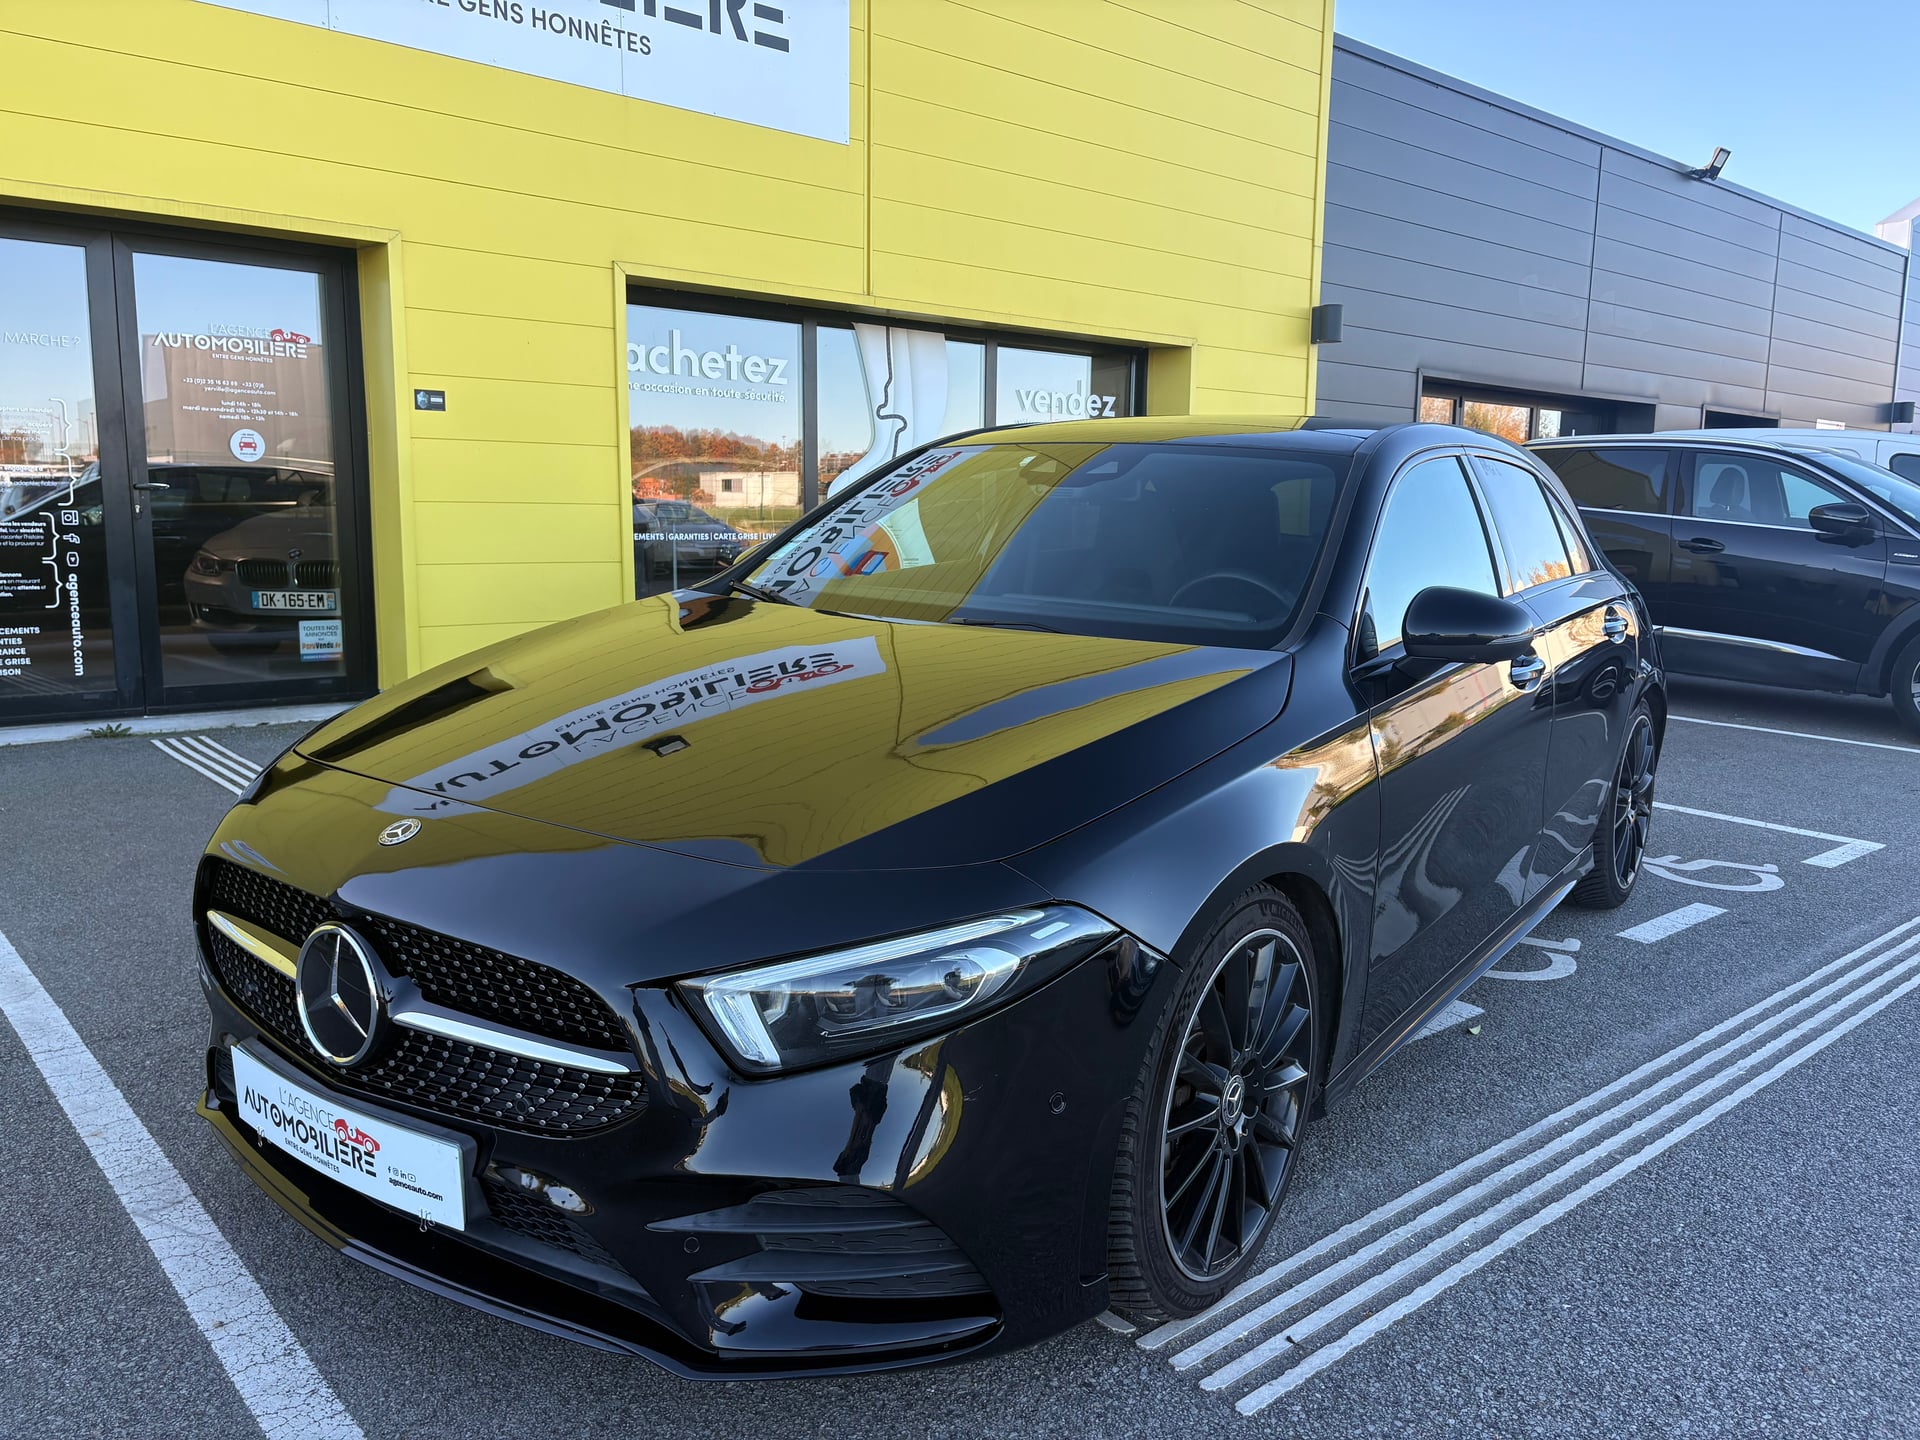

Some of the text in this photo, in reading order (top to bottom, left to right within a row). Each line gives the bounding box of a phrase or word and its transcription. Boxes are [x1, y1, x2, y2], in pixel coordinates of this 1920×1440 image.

[458, 0, 524, 24] GENS
[531, 7, 652, 56] HONNÊTES
[3, 331, 71, 348] MARCHE
[209, 323, 271, 340] L'AGENCE
[627, 328, 789, 385] achetez
[643, 384, 691, 396] occasion
[695, 388, 709, 396] en
[712, 387, 741, 400] toute
[1016, 380, 1116, 417] vendez
[668, 533, 709, 541] GARANTIES
[713, 533, 737, 541] CARTE
[738, 533, 758, 541] GRISE
[66, 573, 84, 676] agenceauto.com
[4, 657, 32, 667] GRISE
[278, 1086, 335, 1132] L'AGENCE
[244, 1085, 377, 1178] AUTOMOBILIERE
[284, 1137, 340, 1174] ENTRE GENS HONNÊTES
[388, 1177, 444, 1202] agenceauto.com
